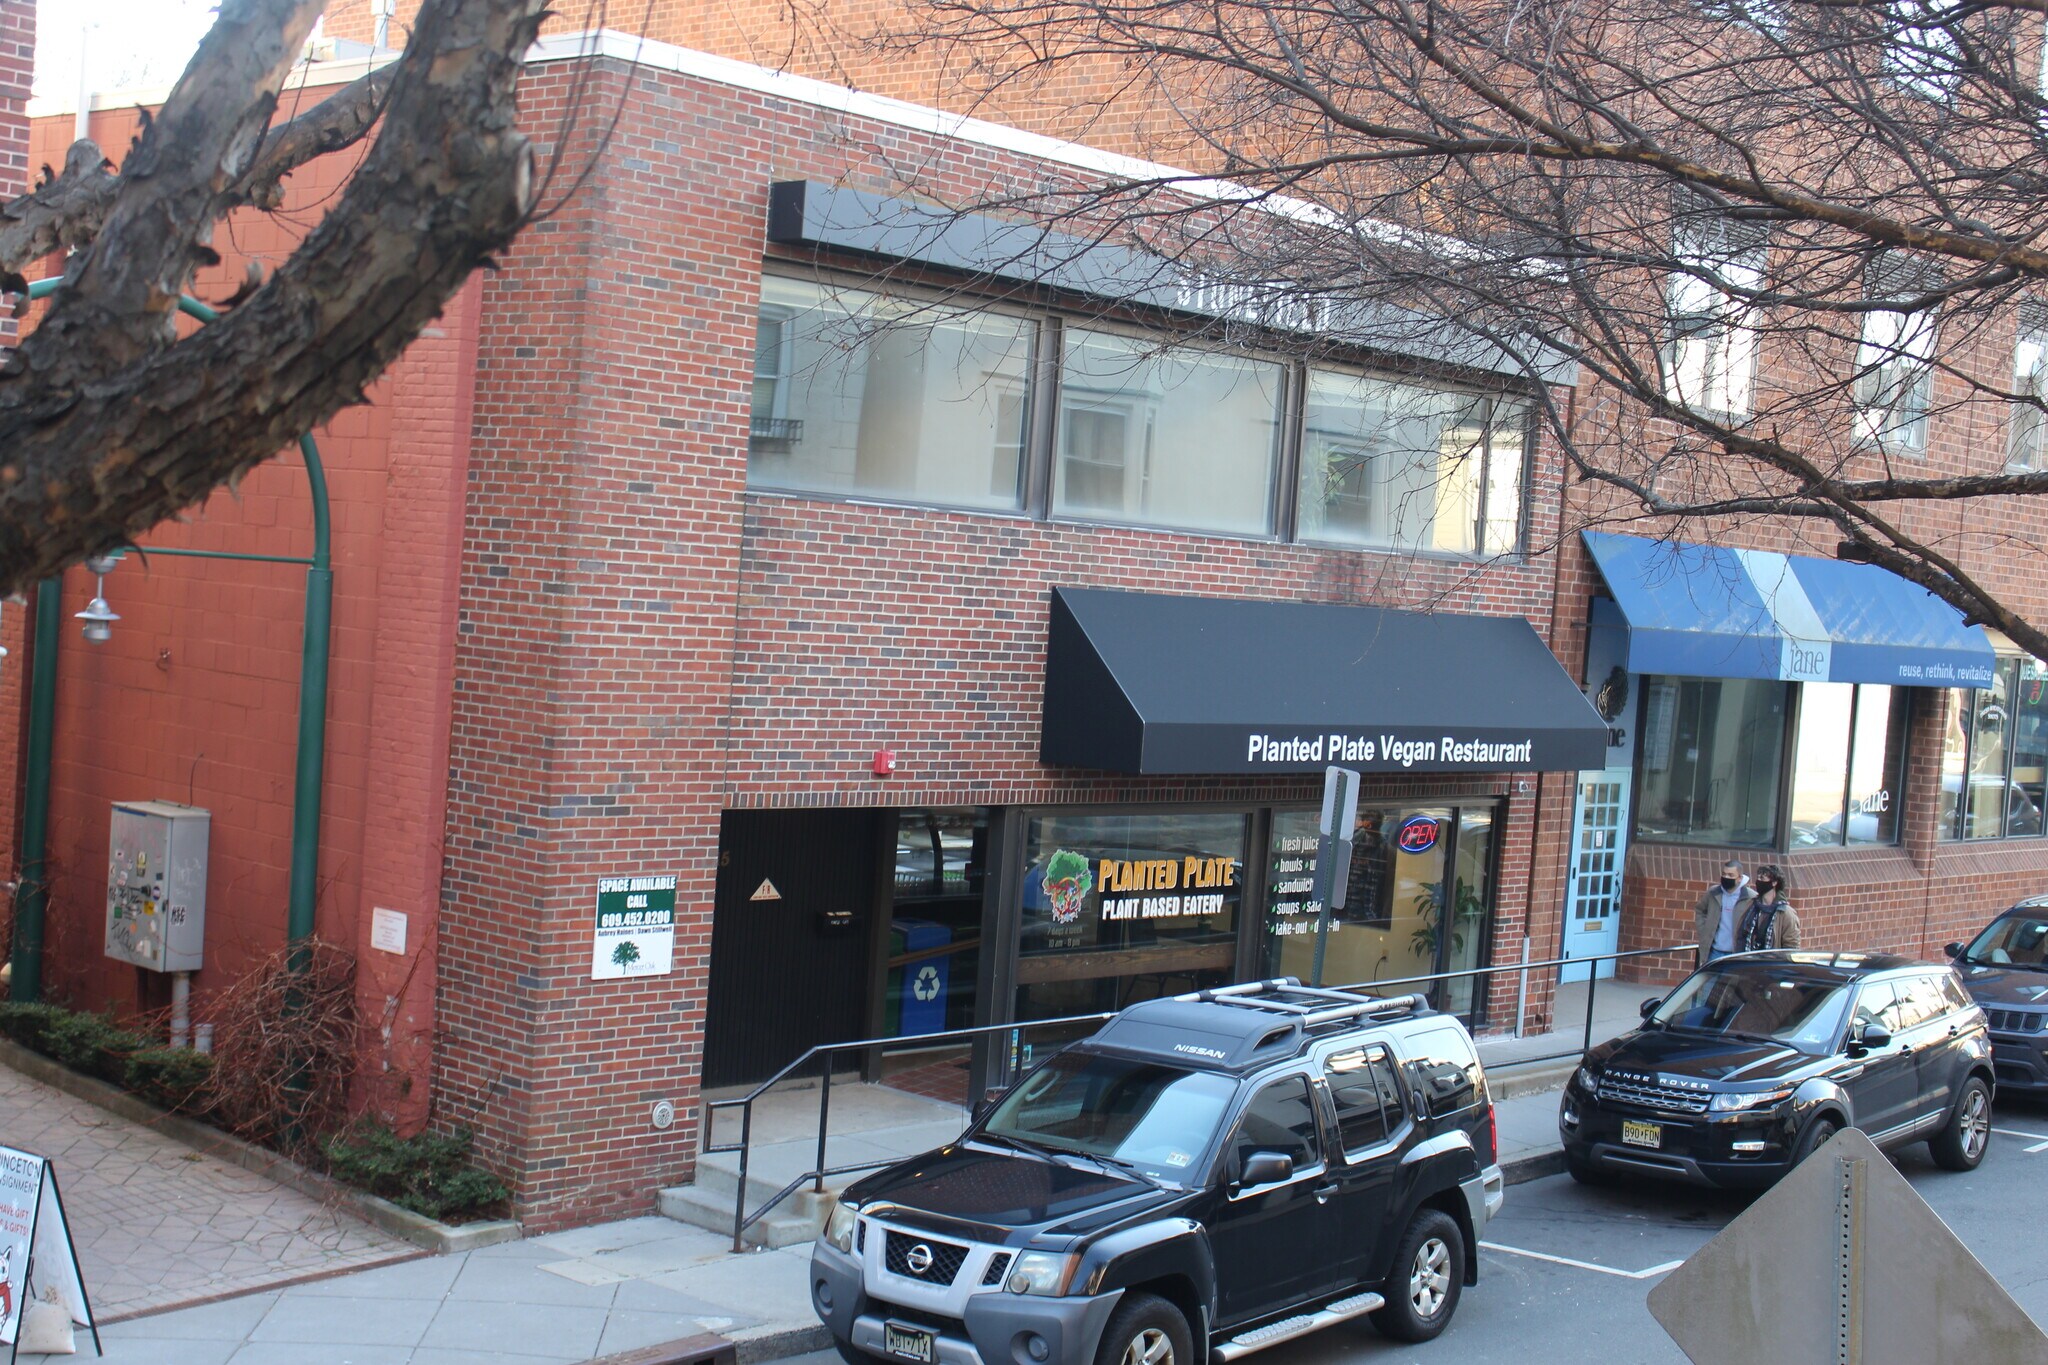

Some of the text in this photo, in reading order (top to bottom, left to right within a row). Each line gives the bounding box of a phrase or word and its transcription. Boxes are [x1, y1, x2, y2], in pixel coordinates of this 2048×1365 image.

[1786, 645, 1824, 679] jane
[1899, 665, 1992, 681] reuse, rethink, revitalize
[1607, 727, 1626, 747] ne
[1248, 735, 1531, 767] Planted Plate Vegan Restaurant
[1620, 809, 1626, 821] 7
[1400, 823, 1439, 846] OPEN
[1281, 835, 1319, 854] fresh juice
[1279, 857, 1303, 873] bowls
[1098, 856, 1235, 893] PLANTED PLATE
[600, 876, 676, 893] SPACE AVAILABLE
[1278, 877, 1314, 894] sandwich
[626, 894, 648, 909] CALL
[1102, 894, 1224, 920] PLANT BASED EATERY
[1276, 901, 1299, 917] soups
[601, 910, 670, 928] 609.452.0200
[1275, 919, 1307, 936] take-out
[1174, 1043, 1226, 1059] NISSAN
[1604, 1069, 1710, 1090] RANGE ROVER
[0, 1152, 42, 1179] INCETON
[0, 1174, 39, 1195] SIGNMENT
[15, 1208, 29, 1221] GIFT
